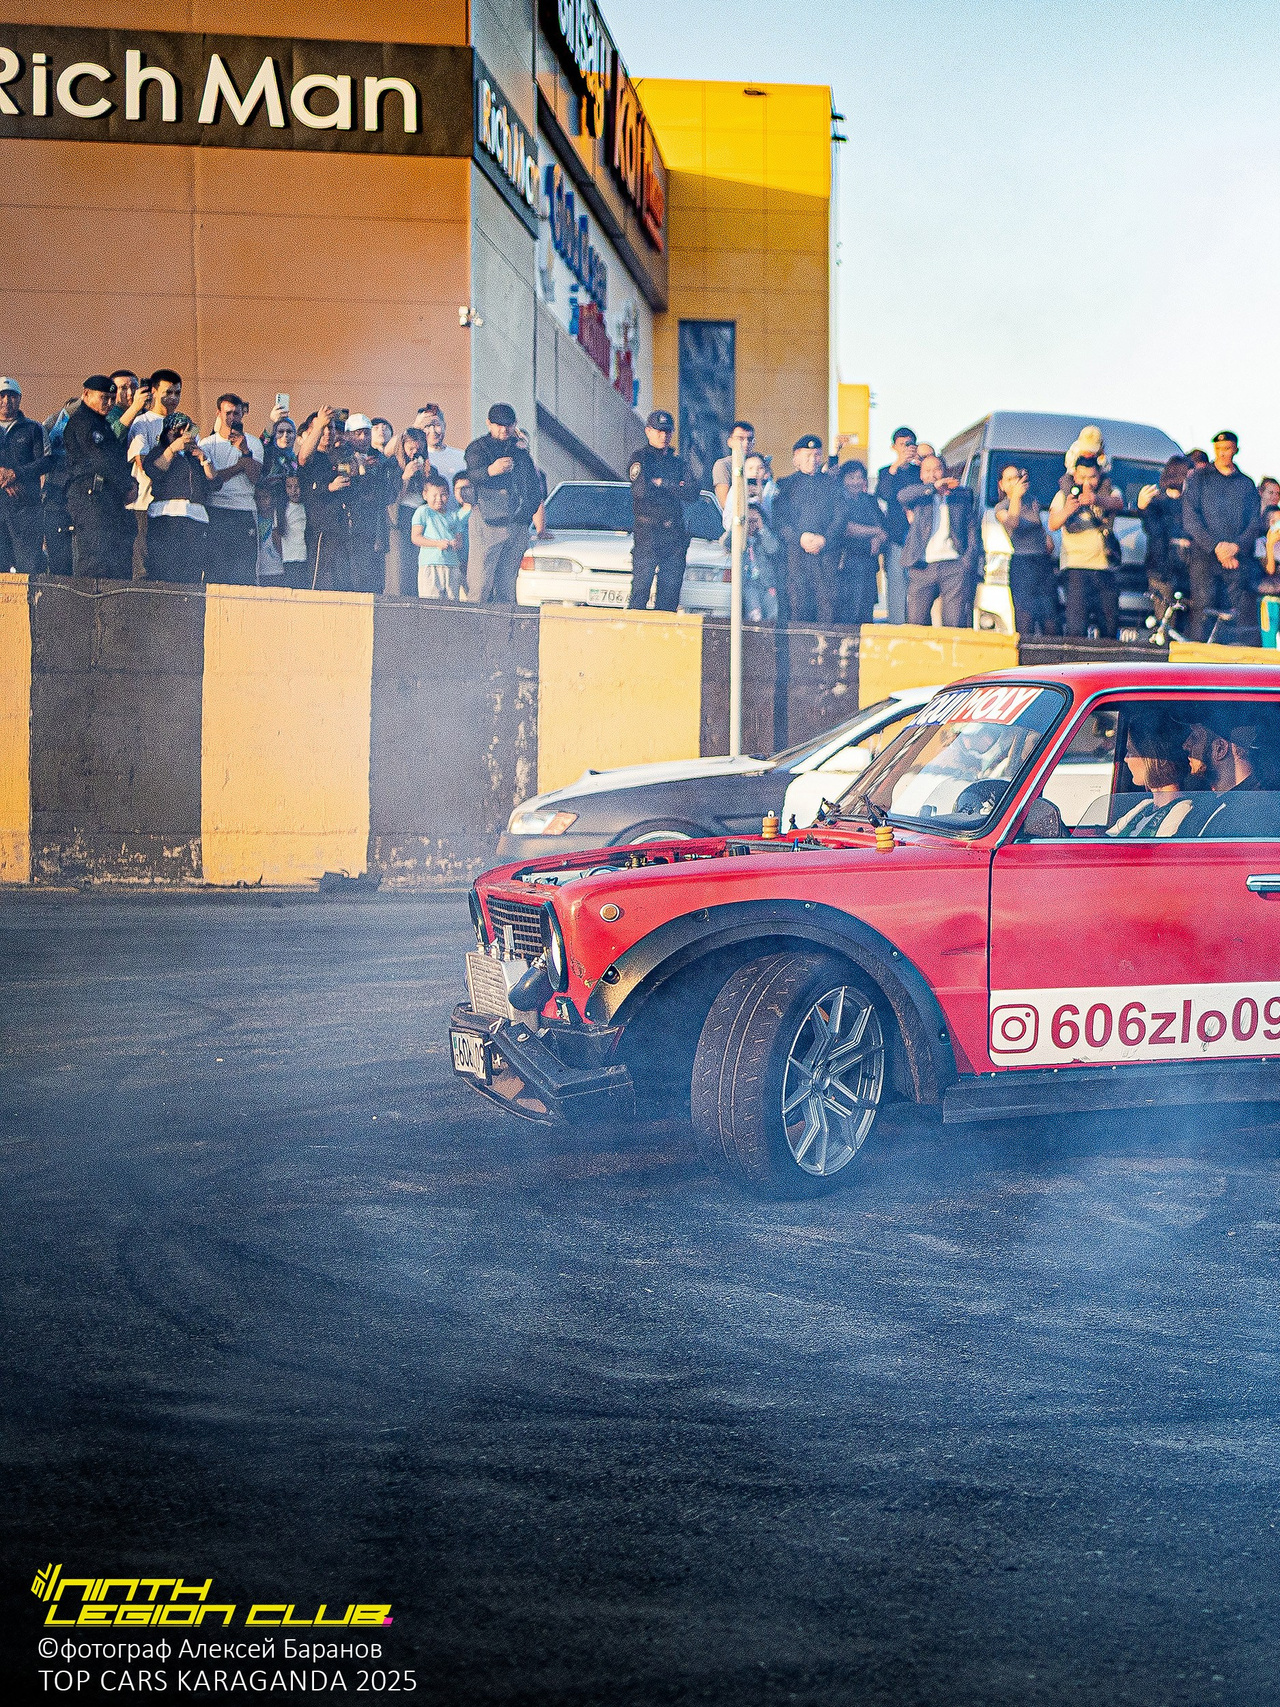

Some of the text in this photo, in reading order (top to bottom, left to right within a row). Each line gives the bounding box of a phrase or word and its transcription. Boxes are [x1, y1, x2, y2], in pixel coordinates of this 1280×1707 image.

[198, 53, 417, 133] Man
[477, 79, 512, 178] Rich
[951, 687, 1038, 721] MOLY
